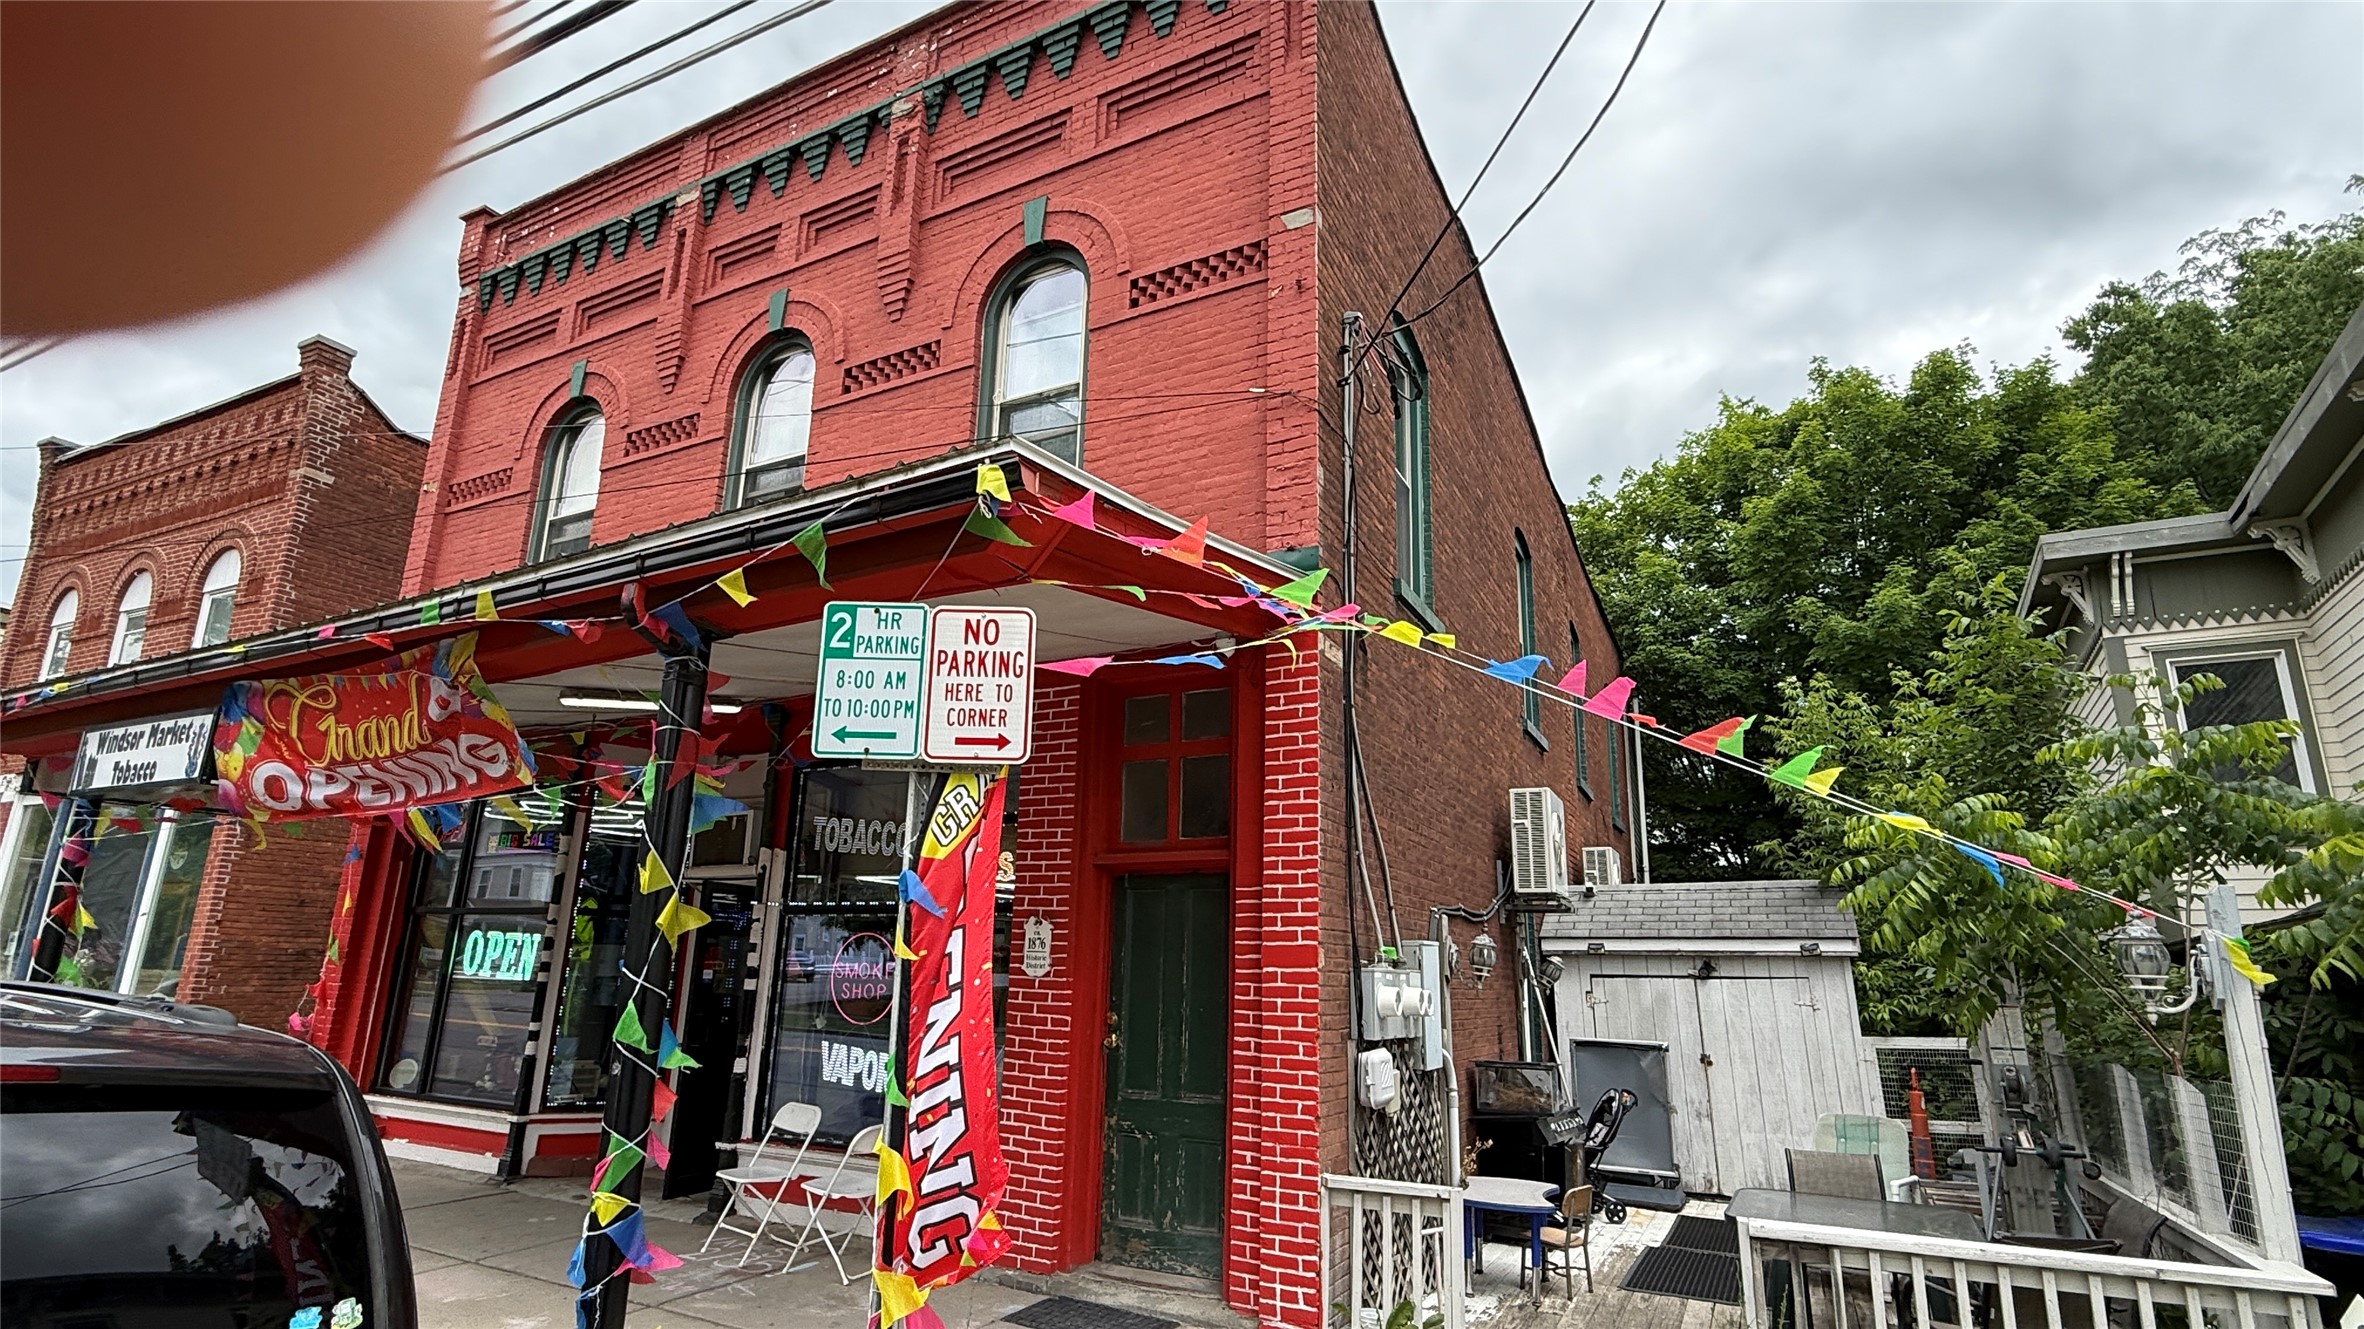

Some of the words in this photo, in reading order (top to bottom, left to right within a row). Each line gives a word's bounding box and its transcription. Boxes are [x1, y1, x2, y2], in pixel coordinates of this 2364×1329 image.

[829, 612, 852, 648] 2
[877, 612, 902, 630] HR
[964, 618, 1000, 645] NO
[856, 635, 920, 655] PARKING
[936, 650, 1024, 678] PARKING
[836, 669, 875, 689] 8:00
[884, 671, 906, 690] AM
[945, 683, 984, 702] HERE
[996, 684, 1013, 703] TO
[265, 671, 431, 767] Grand
[824, 698, 842, 718] TO
[947, 708, 1007, 727] CORNER
[97, 728, 146, 755] Windsor
[146, 720, 193, 748] Market
[111, 760, 157, 785] Tobacco
[251, 733, 506, 811] OPENING
[500, 833, 518, 847] BIG
[523, 833, 554, 847] SALE
[463, 930, 541, 980] OPEN
[1028, 937, 1046, 950] 1876
[841, 983, 886, 1000] SHOP
